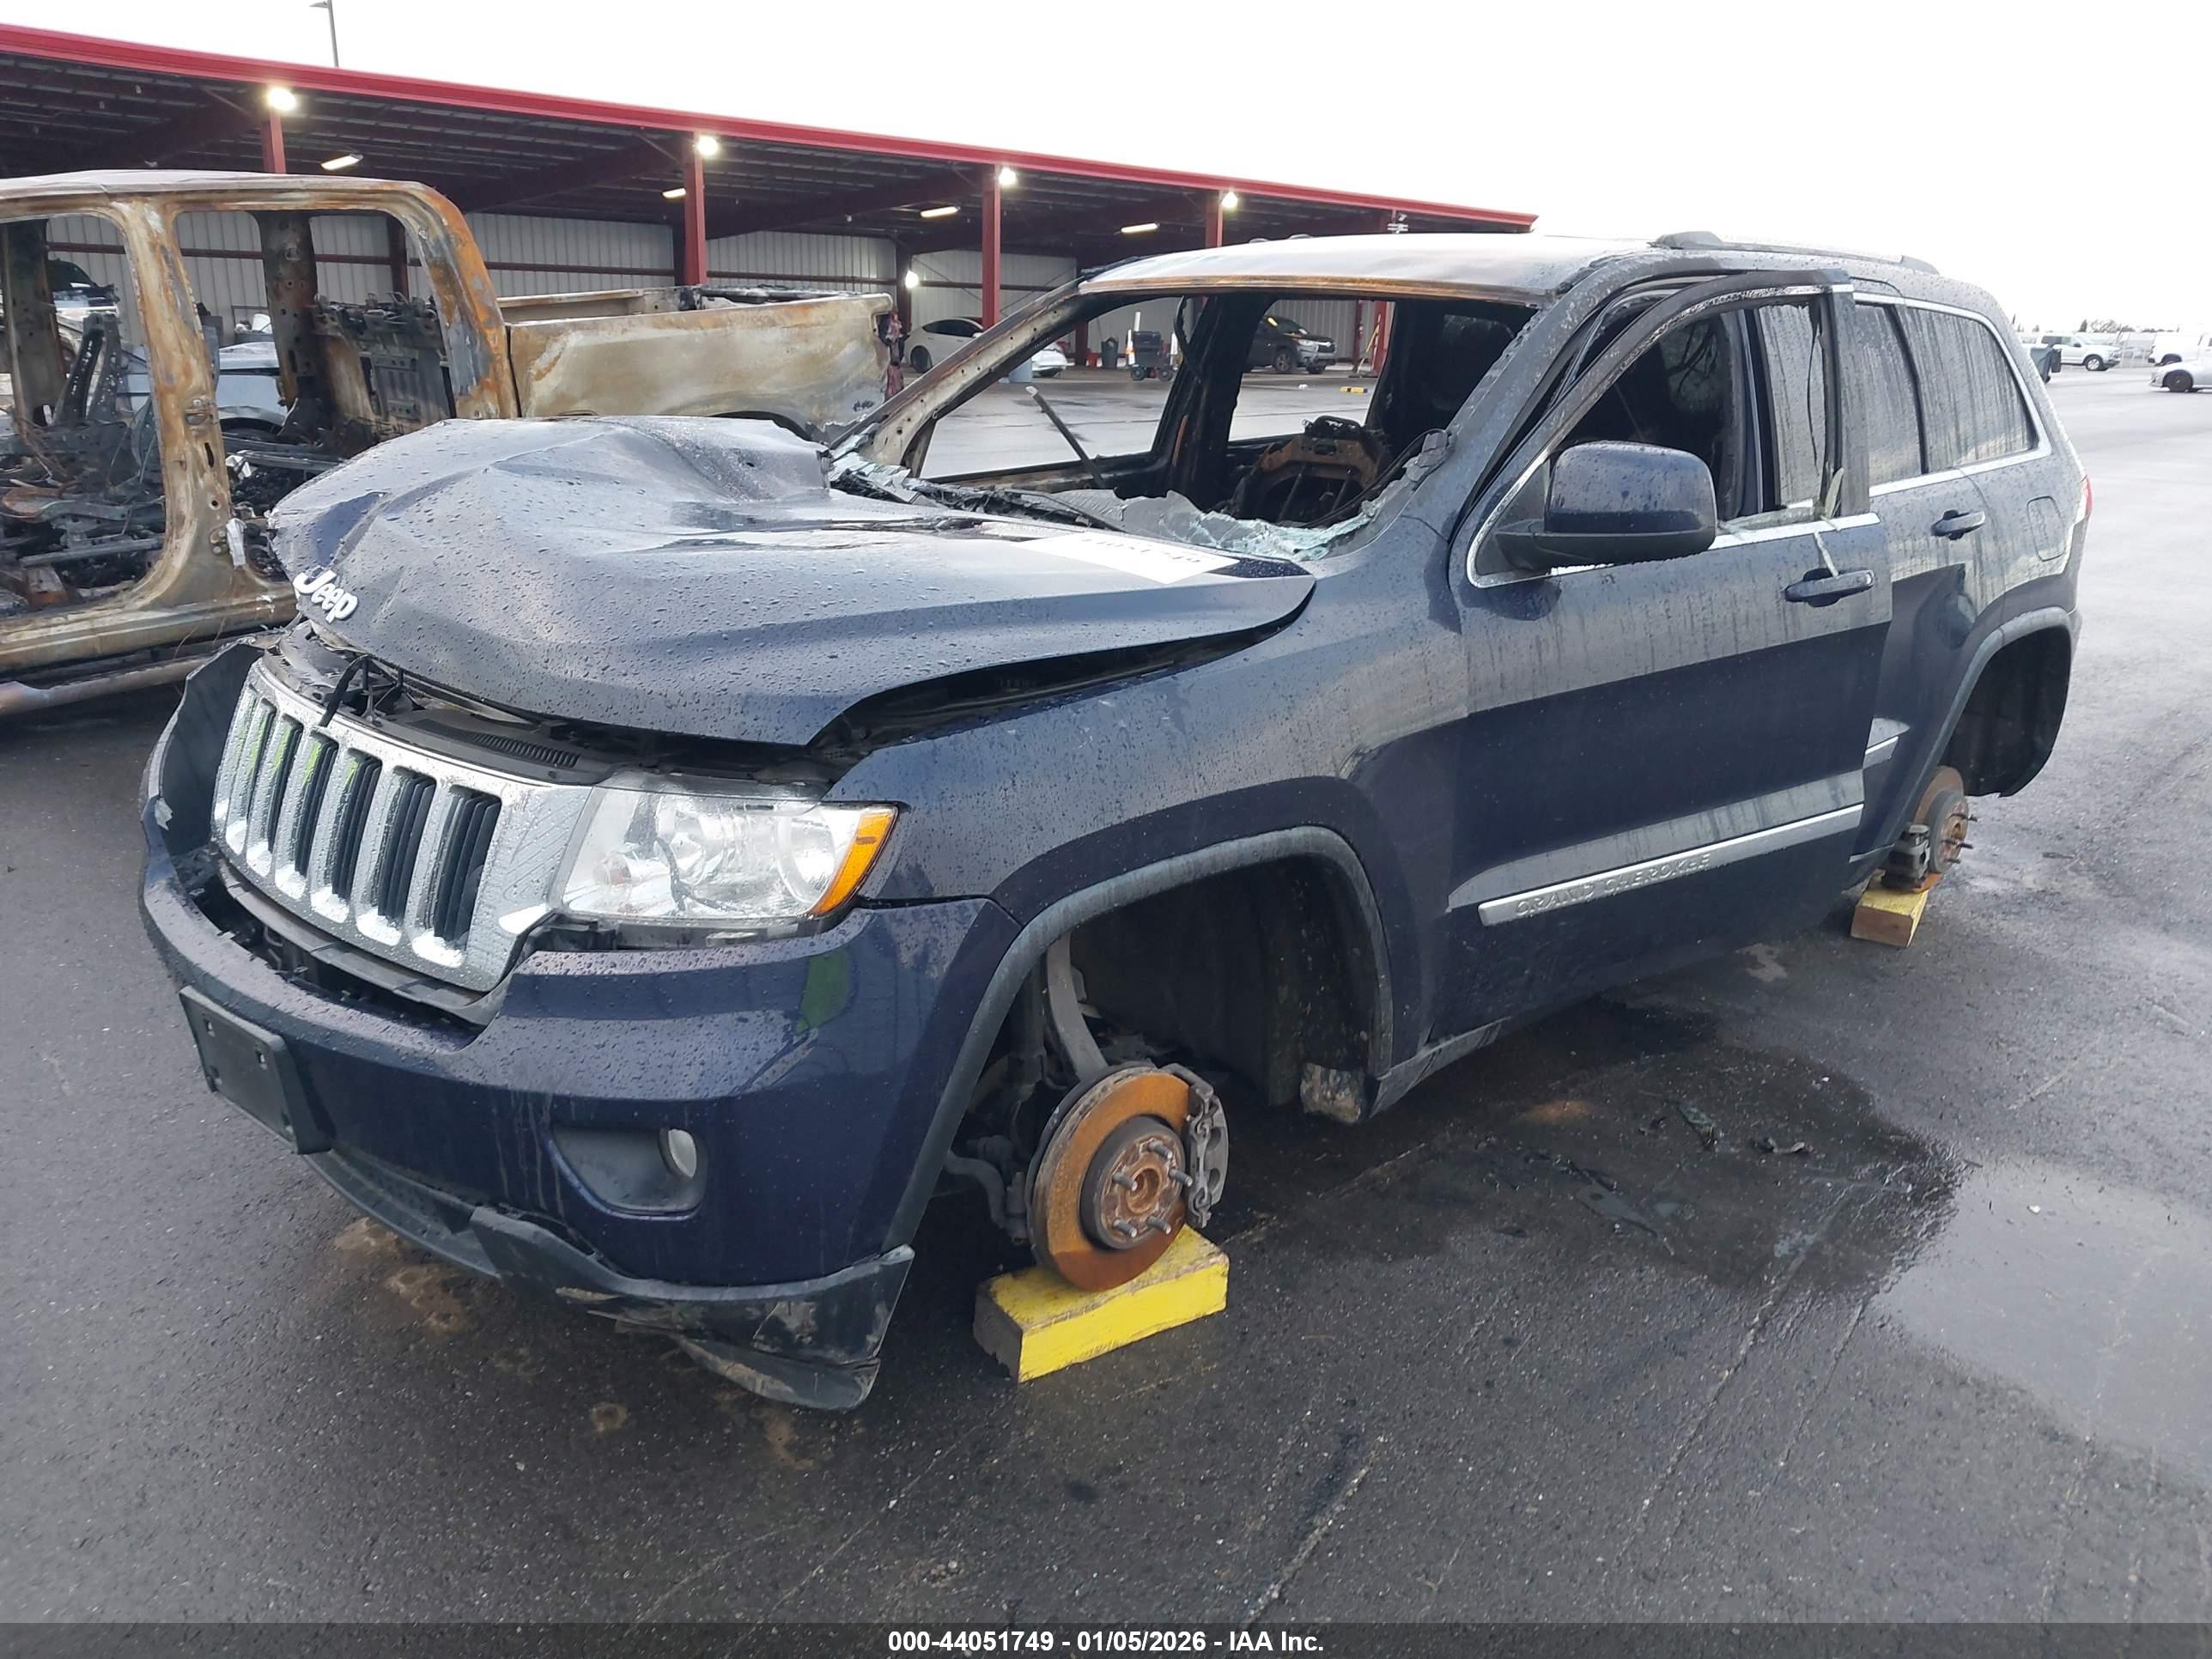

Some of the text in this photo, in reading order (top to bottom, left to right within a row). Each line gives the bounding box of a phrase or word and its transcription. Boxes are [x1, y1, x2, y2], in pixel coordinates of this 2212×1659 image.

[293, 569, 358, 624] Jeep
[1516, 854, 1711, 916] GRAND CHEROKEE
